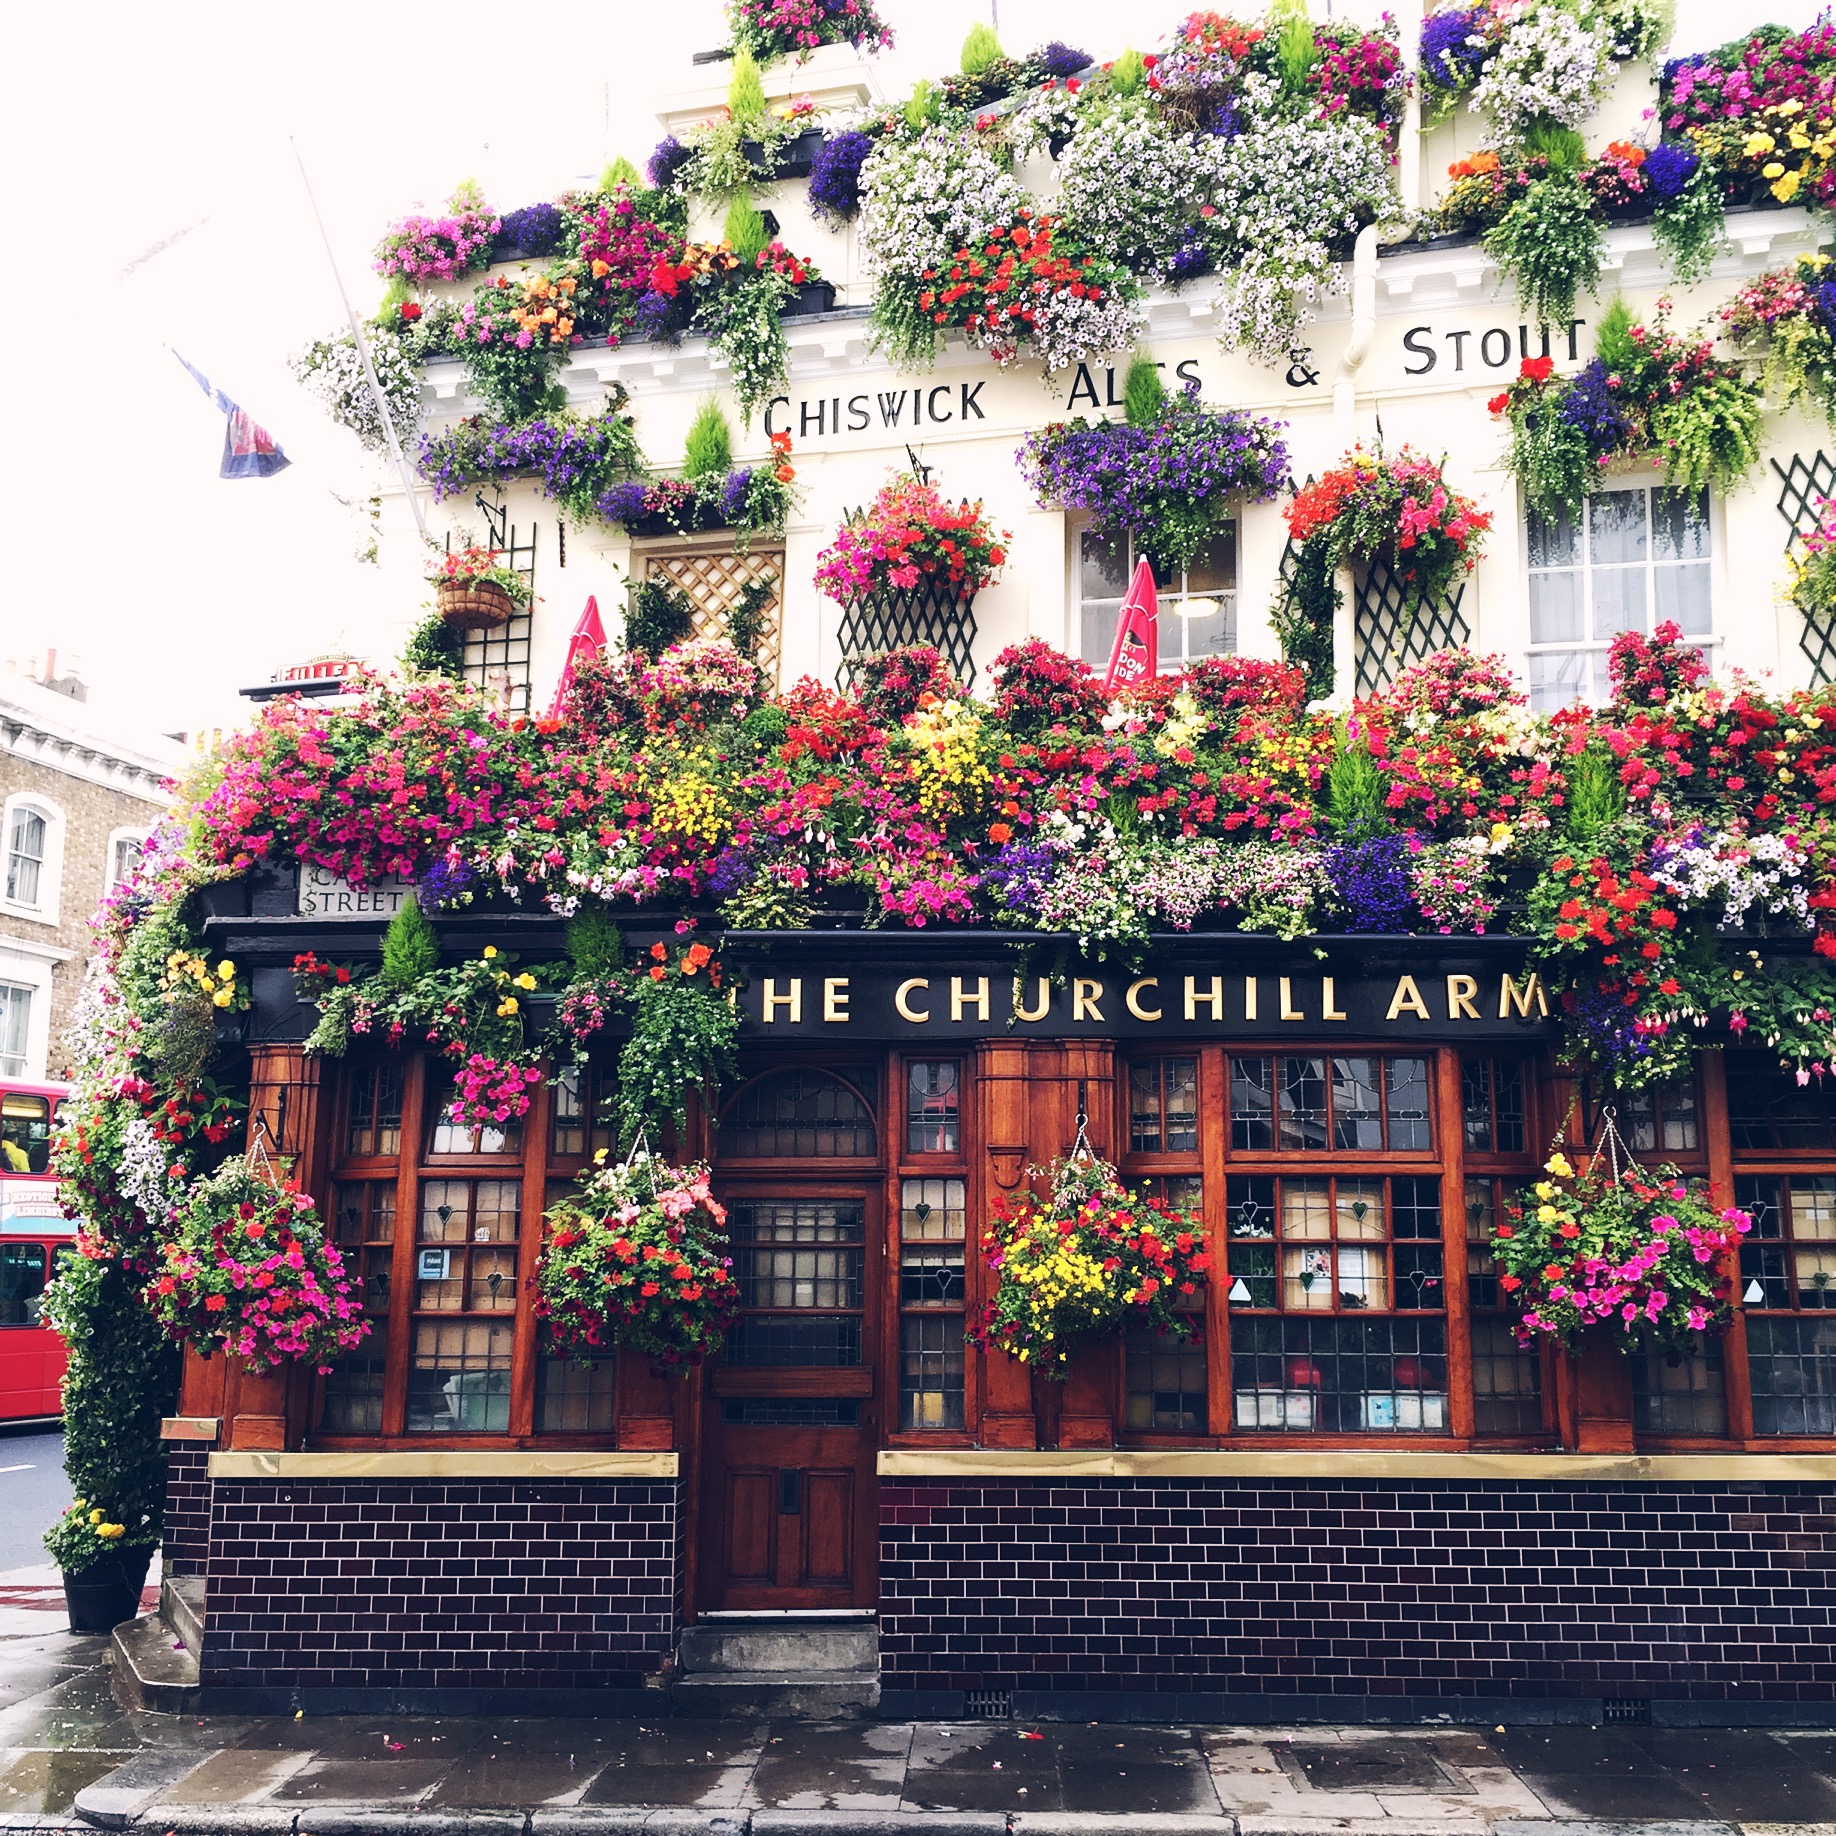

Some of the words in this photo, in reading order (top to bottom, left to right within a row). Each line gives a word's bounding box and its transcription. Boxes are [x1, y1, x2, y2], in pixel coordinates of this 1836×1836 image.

[764, 381, 987, 439] CHISWICK
[1066, 359, 1202, 411] ALS
[1402, 318, 1587, 375] STOUT
[1113, 664, 1136, 682] IDE
[1118, 651, 1147, 675] DON
[304, 891, 404, 912] STREET
[894, 975, 1347, 1023] CHURCHILL
[1385, 972, 1578, 1020] ARM
